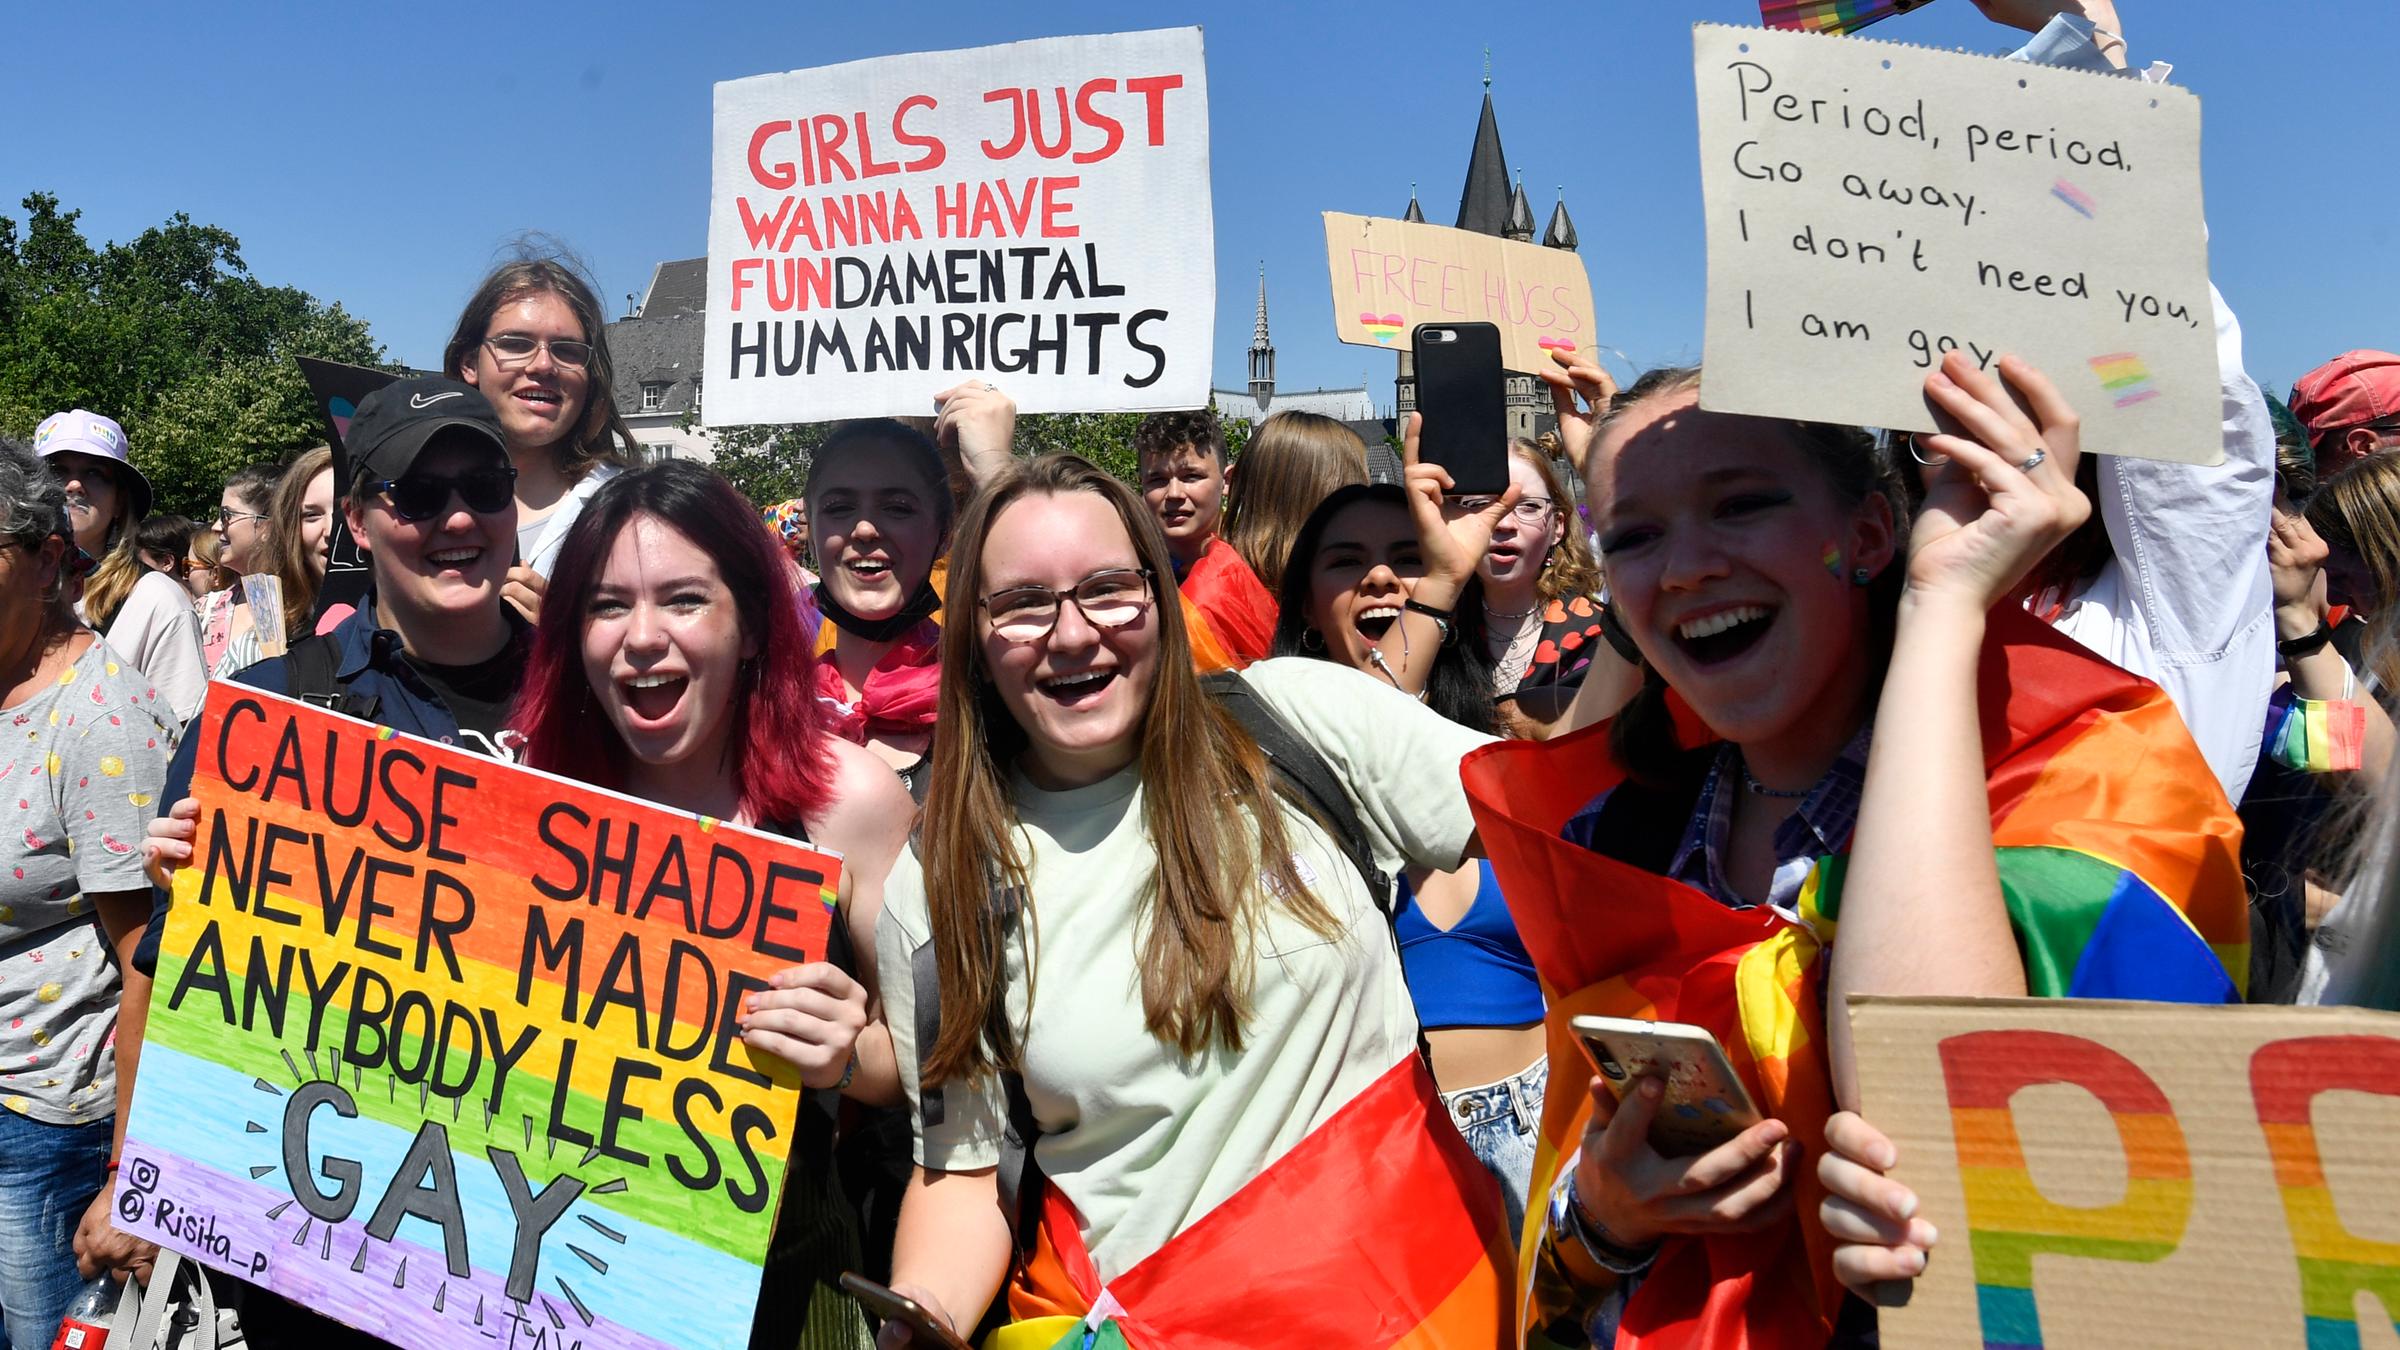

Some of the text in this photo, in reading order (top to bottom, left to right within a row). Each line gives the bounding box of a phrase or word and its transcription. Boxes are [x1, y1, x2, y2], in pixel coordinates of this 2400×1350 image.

[747, 74, 1184, 190] GIRLS JUST
[1727, 61, 1940, 151] Period,
[735, 175, 1080, 253] WANNA HAVE
[1733, 141, 1986, 226] Go away.
[731, 243, 1126, 312] FUNDAMENTAL
[1351, 248, 1580, 333] FREE HUGS
[1740, 209, 2199, 328] I don't need you,
[729, 309, 1169, 389] HUMAN RIGHTS
[1746, 289, 1753, 328] I
[1801, 313, 1870, 340] am
[217, 700, 824, 959] CAUSE SHADE
[199, 809, 476, 983] NEVER
[168, 920, 777, 1213] ANYBODY LESS
[282, 1080, 585, 1304] GAY
